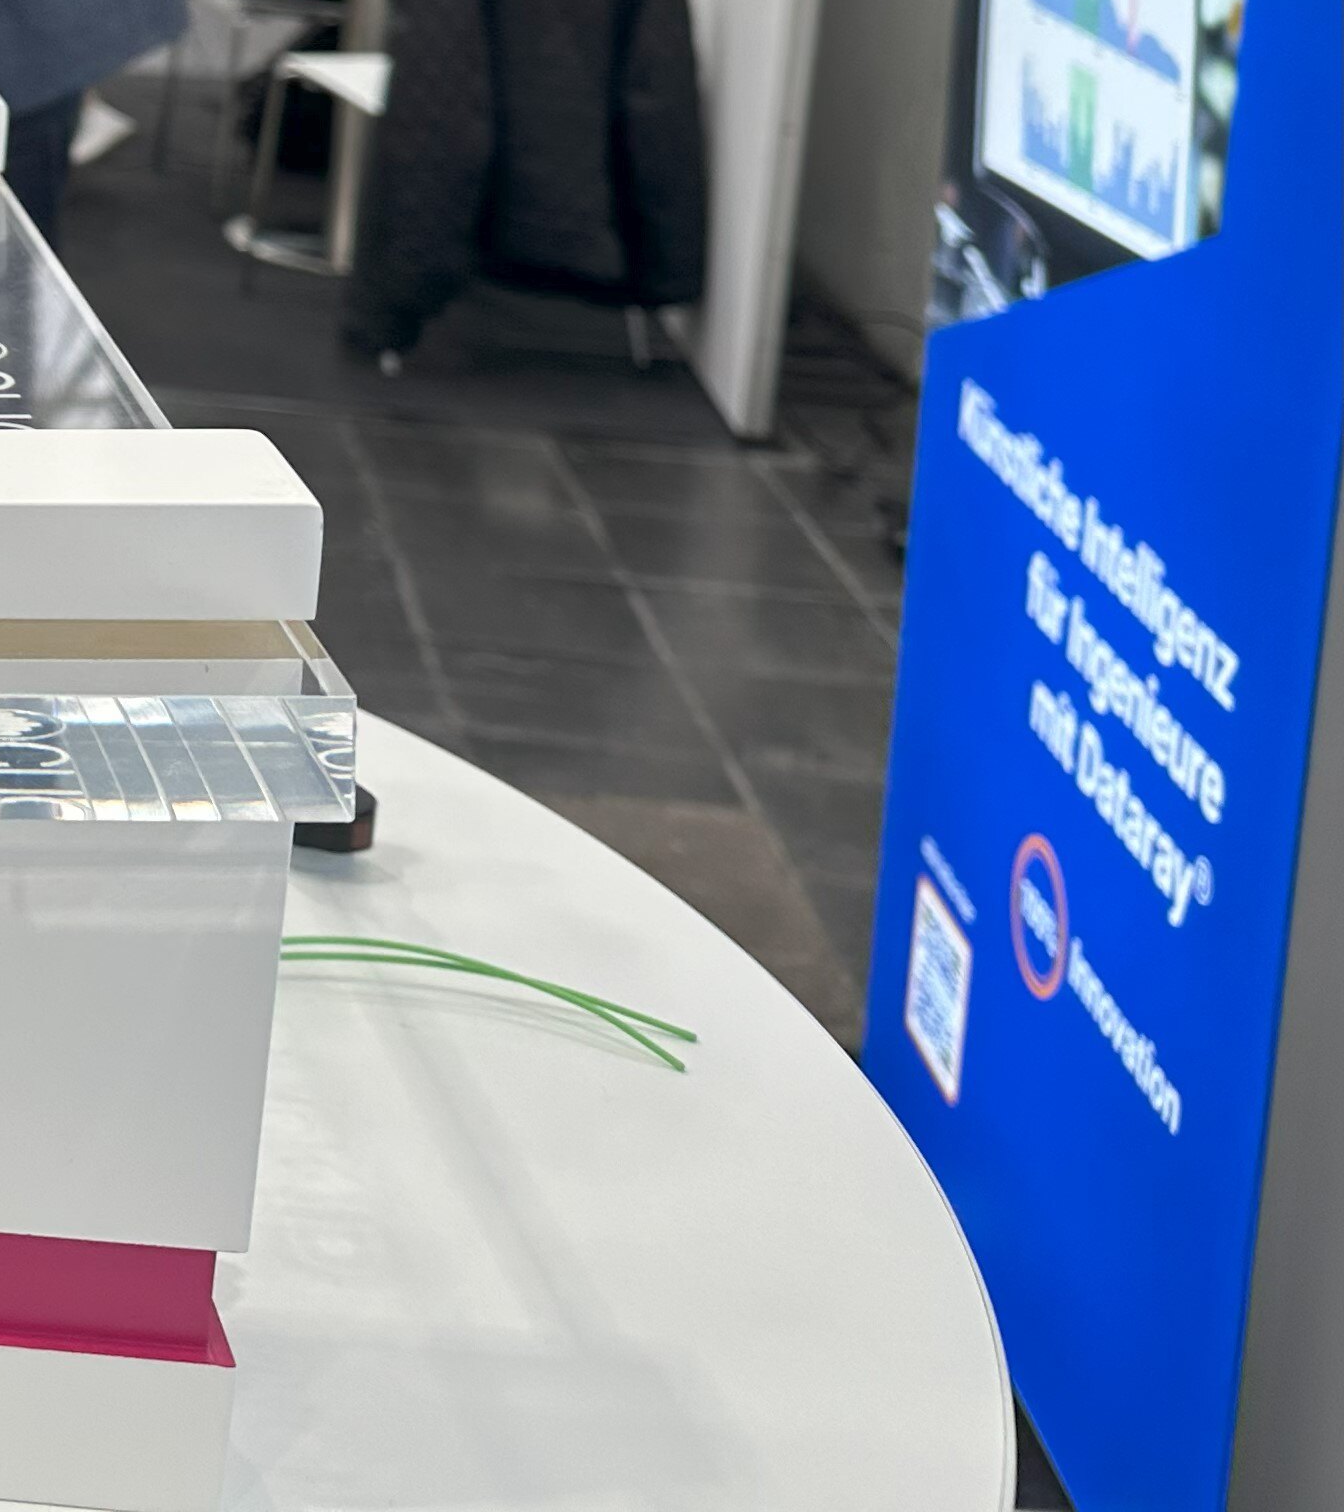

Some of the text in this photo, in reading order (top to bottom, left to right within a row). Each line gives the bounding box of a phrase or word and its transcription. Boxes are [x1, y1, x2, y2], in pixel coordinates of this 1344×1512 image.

[958, 377, 1239, 711] Künstliche Intelligenz
[1026, 550, 1226, 824] für Ingenieure
[1029, 679, 1078, 775] mit
[1067, 936, 1182, 1132] Innovation
